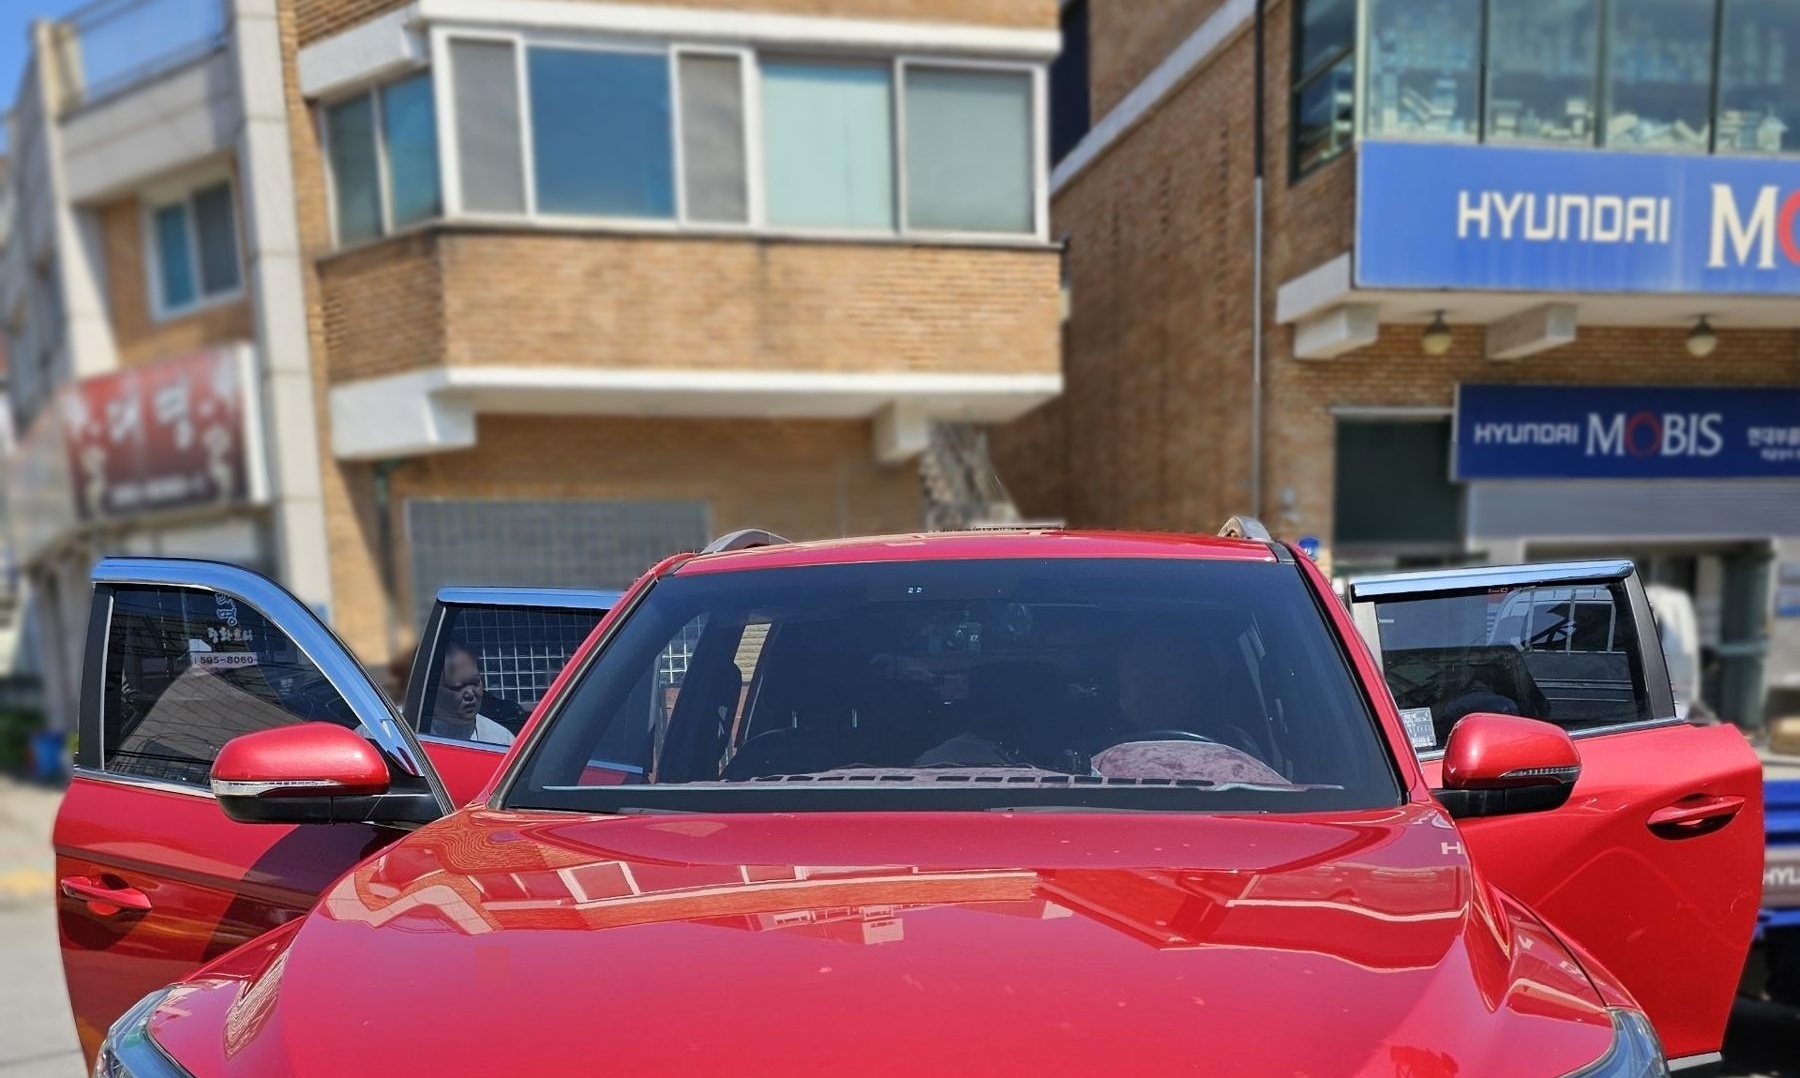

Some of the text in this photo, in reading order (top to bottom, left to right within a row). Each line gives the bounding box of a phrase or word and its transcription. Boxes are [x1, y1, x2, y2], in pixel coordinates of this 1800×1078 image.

[1458, 191, 1671, 243] HYUNDAI
[1474, 411, 1723, 458] HYUNDAI MOBIS
